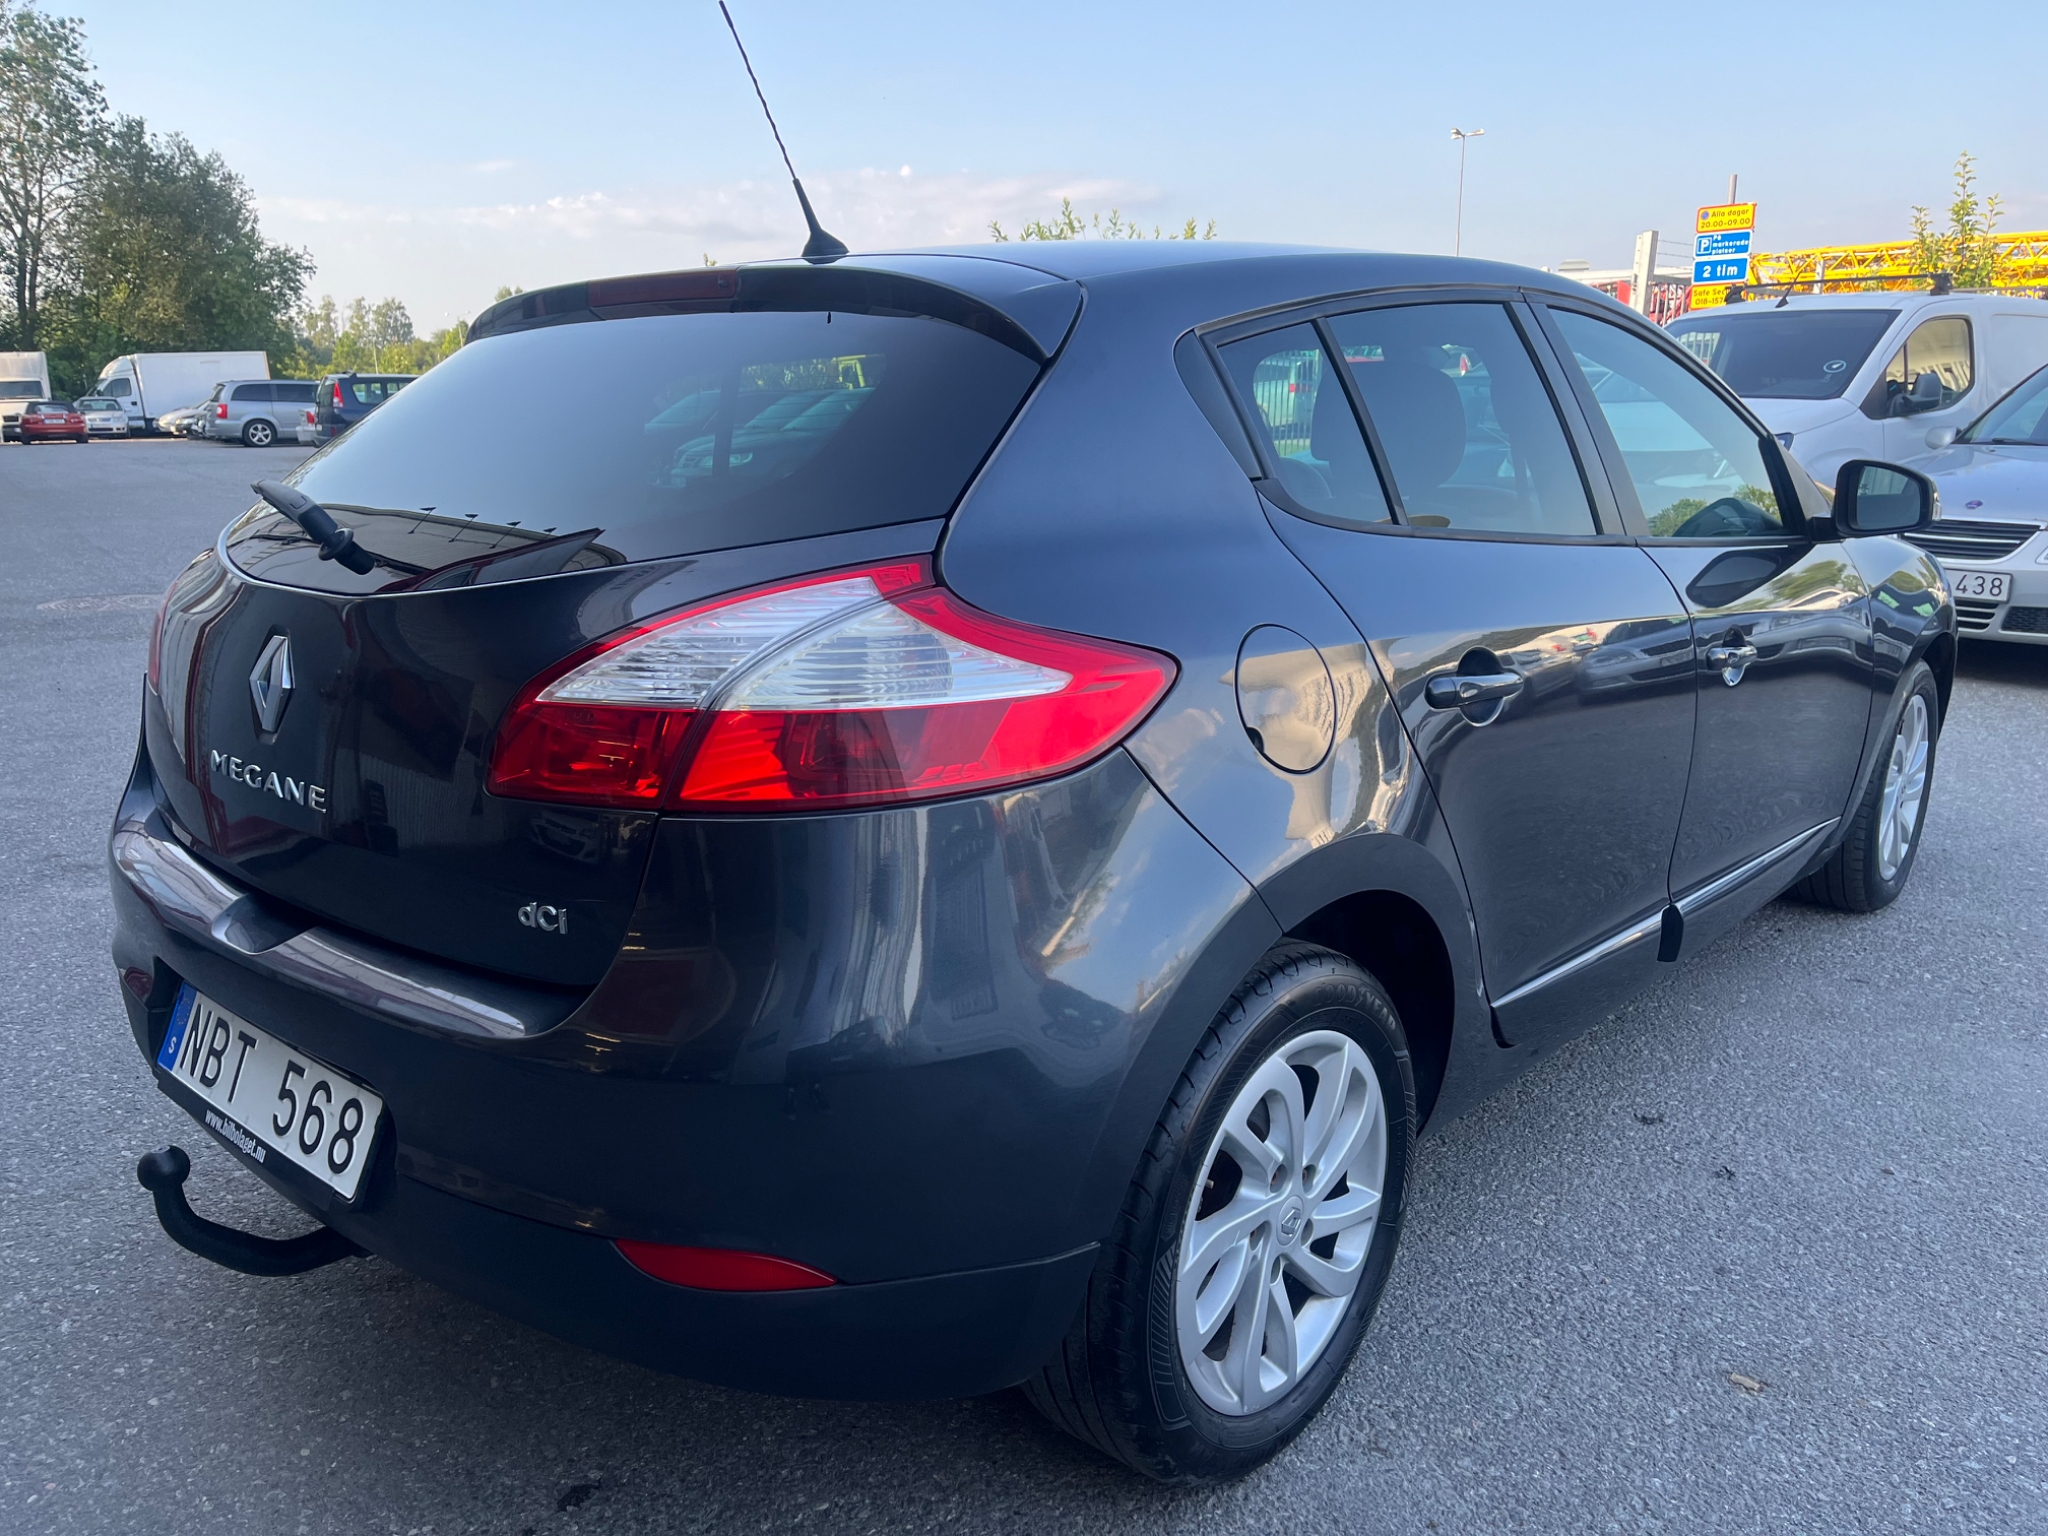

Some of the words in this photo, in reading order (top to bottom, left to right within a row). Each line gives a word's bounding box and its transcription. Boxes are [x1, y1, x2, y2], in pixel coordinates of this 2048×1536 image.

[1727, 209, 1750, 217] dagar
[1702, 265, 1712, 278] 2
[1716, 263, 1738, 277] tim
[1693, 289, 1710, 297] Safe
[1955, 574, 2003, 597] 438
[210, 749, 327, 813] MEGANE
[168, 1036, 178, 1054] S
[179, 1003, 258, 1104] NBT
[272, 1059, 364, 1175] 568
